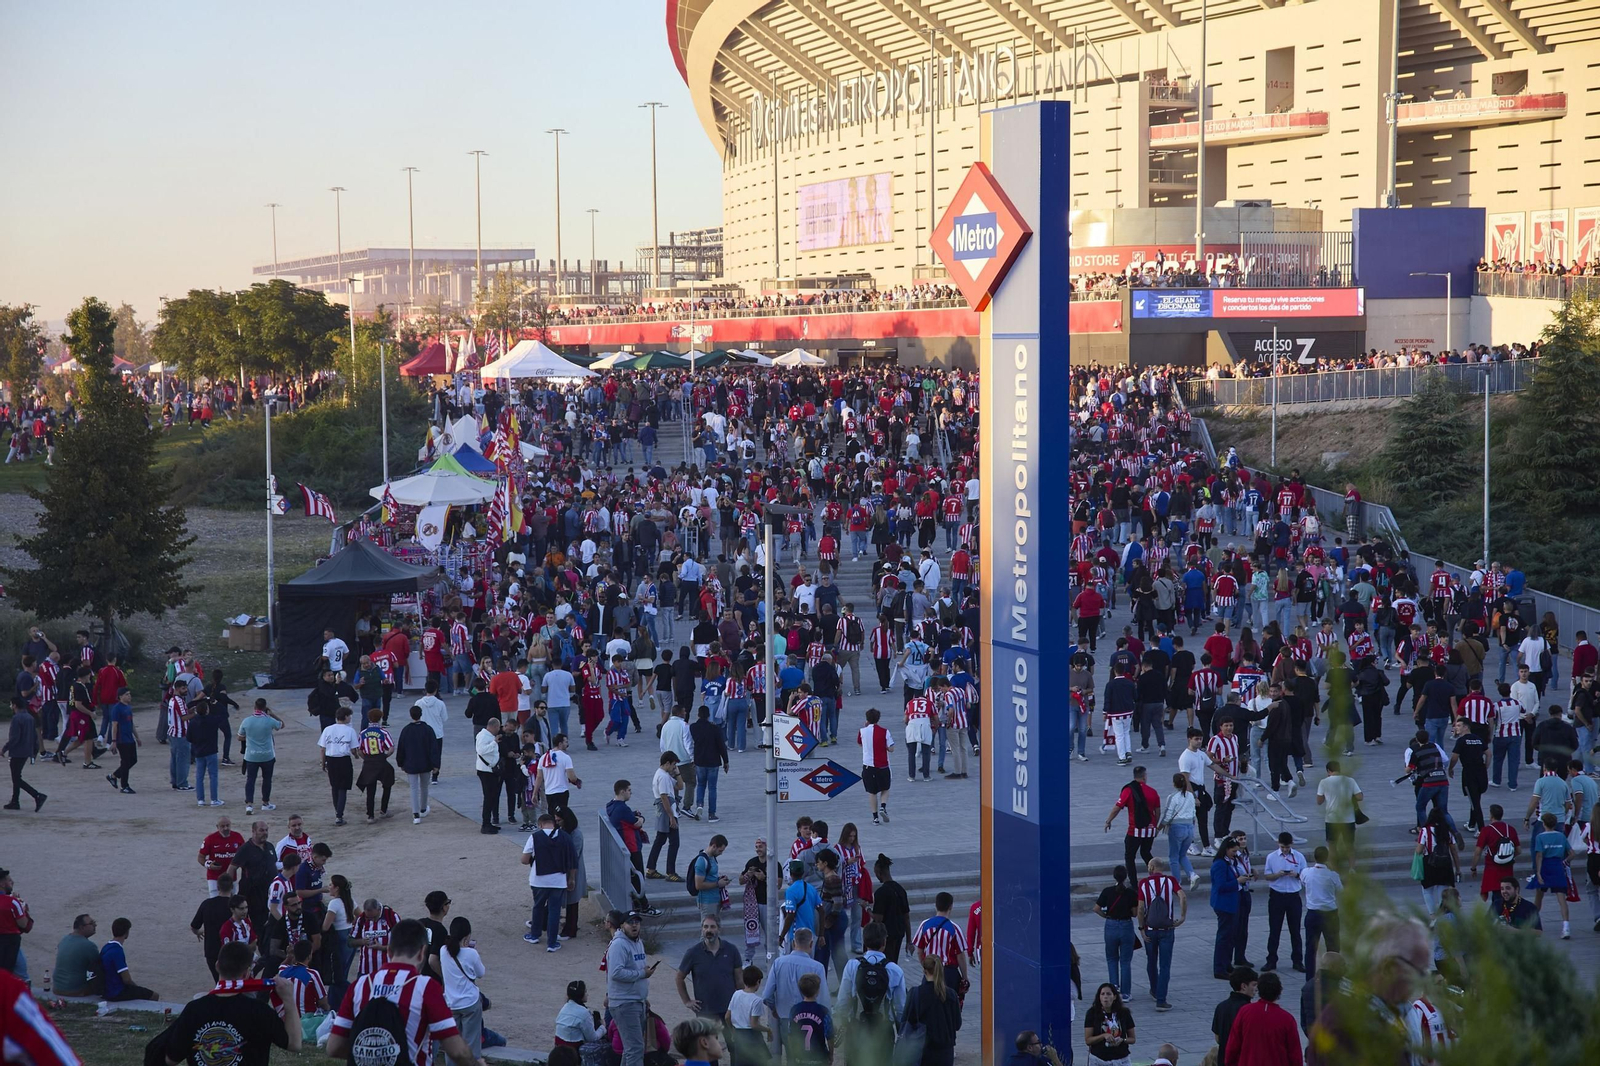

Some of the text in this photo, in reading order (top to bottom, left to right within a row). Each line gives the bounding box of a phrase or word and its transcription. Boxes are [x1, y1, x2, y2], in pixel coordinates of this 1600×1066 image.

[826, 45, 1016, 127] METROPOLITANO
[1480, 99, 1515, 110] MADRID
[955, 223, 995, 252] Metro
[1084, 253, 1120, 267] STORE
[1223, 303, 1312, 312] y conciertos los días de partido
[1254, 337, 1317, 365] ACCESO Z
[951, 501, 957, 511] 7
[1283, 495, 1292, 505] 17
[1011, 344, 1031, 817] Estadio Metropolitano
[1439, 576, 1446, 587] 4
[335, 650, 342, 662] 9
[811, 646, 822, 656] 11
[912, 652, 922, 664] 14
[711, 687, 718, 696] 7
[912, 700, 927, 713] 13
[193, 1022, 211, 1042] MAUI
[227, 1023, 244, 1042] SONS
[801, 1024, 814, 1051] 7
[354, 1045, 396, 1058] SAMCRO
